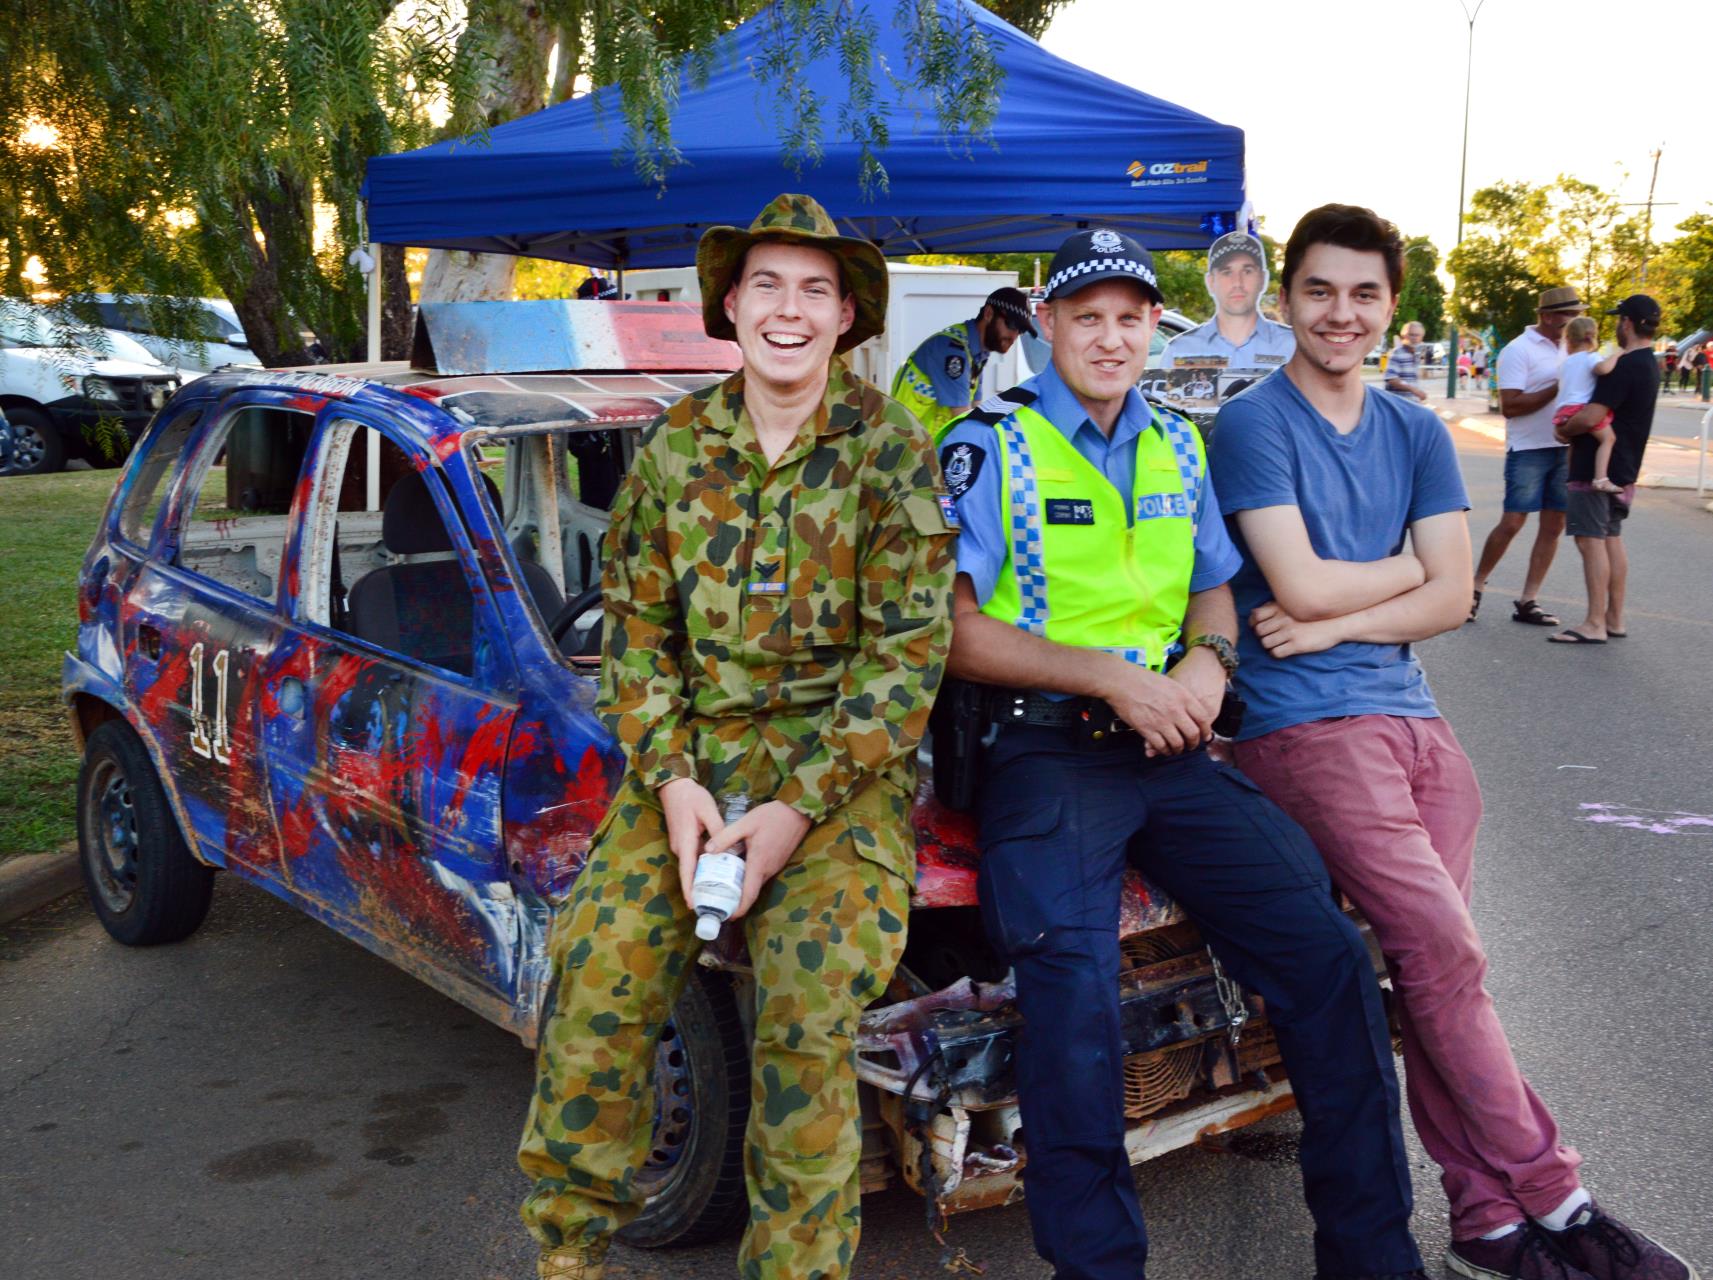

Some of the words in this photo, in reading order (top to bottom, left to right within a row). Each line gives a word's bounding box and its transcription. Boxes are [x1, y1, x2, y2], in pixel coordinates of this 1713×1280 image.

[1090, 245, 1126, 253] POLICE
[1138, 495, 1186, 517] OLICE
[189, 643, 231, 765] 11
